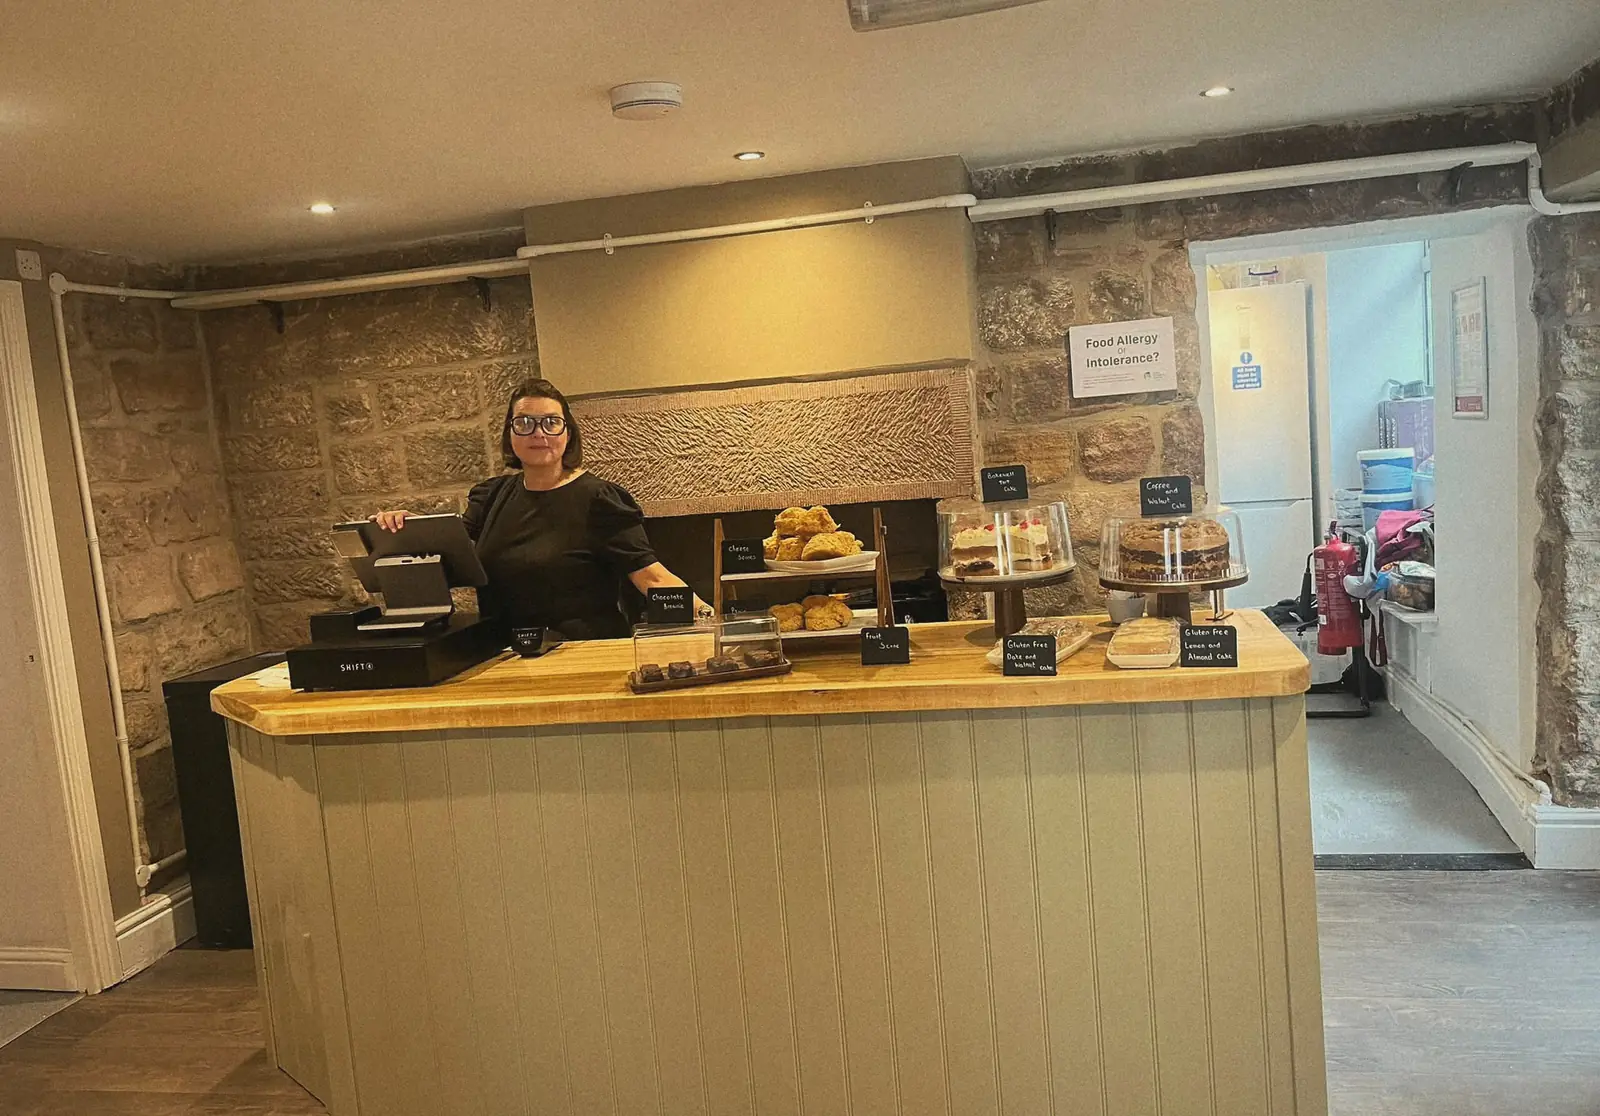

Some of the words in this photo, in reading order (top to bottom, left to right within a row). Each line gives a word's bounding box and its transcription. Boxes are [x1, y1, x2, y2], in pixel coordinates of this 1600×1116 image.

[1086, 337, 1114, 349] Food
[1117, 334, 1158, 346] Allergy
[1086, 352, 1160, 368] Intolerance?
[1146, 481, 1170, 491] Coffee
[652, 593, 684, 601] Chocolate
[865, 632, 882, 640] Fruit
[1184, 628, 1210, 637] Gluten
[1007, 639, 1030, 649] Gluten
[1184, 641, 1206, 649] Lemon
[1208, 641, 1221, 649] and
[1006, 652, 1022, 660] Date
[1188, 652, 1213, 660] Almond
